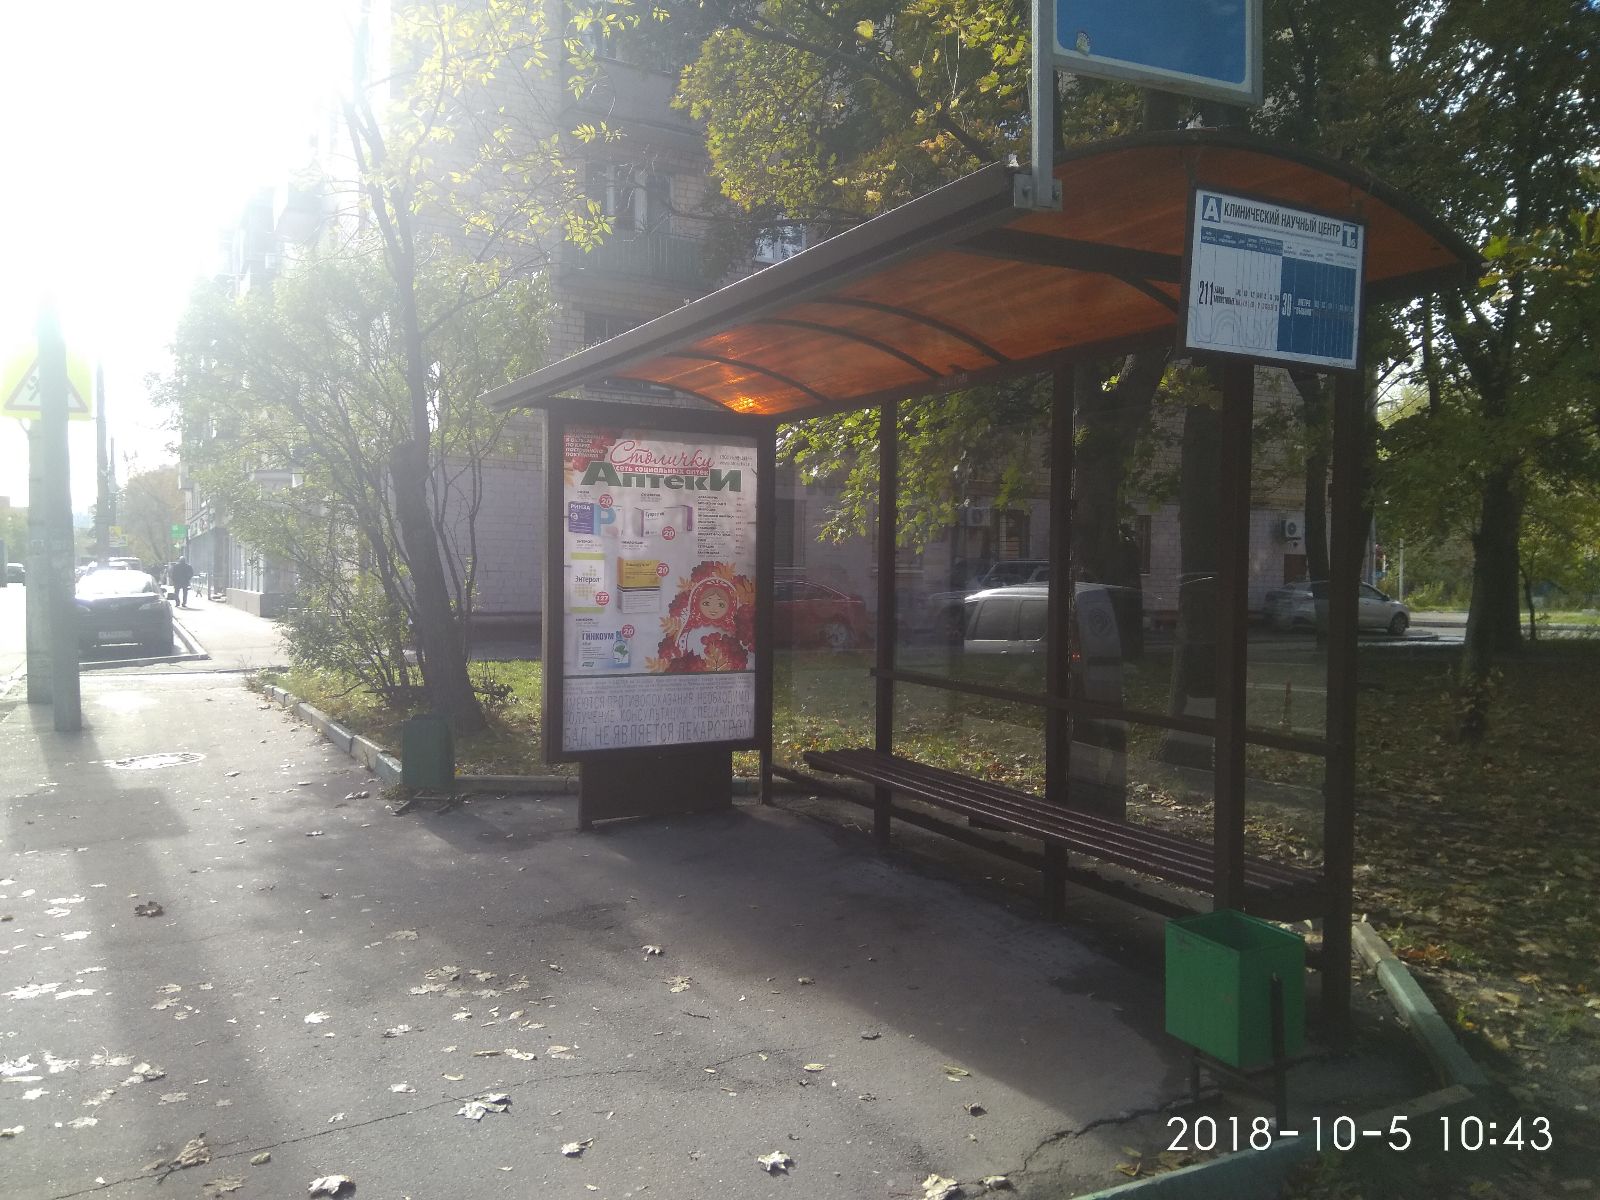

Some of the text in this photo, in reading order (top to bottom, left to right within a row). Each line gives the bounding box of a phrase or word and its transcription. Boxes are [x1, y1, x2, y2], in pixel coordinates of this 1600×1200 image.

[1224, 202, 1280, 225] КЛИНИЧЕСКИЙ
[1281, 214, 1317, 233] НАУЧНЫЙ
[1318, 221, 1341, 238] ЦЕНТР
[1199, 280, 1214, 305] 211
[1282, 293, 1292, 316] 30
[610, 440, 715, 468] Столички
[615, 464, 709, 477] сеть социальных аптек
[575, 576, 600, 584] Энтерол
[582, 632, 615, 641] ГИНКОУМ
[594, 725, 610, 745] НЕ
[613, 721, 674, 745] ЯВЛЯЕТСЯ
[677, 718, 752, 742] ЛЕКАРСТВОМ
